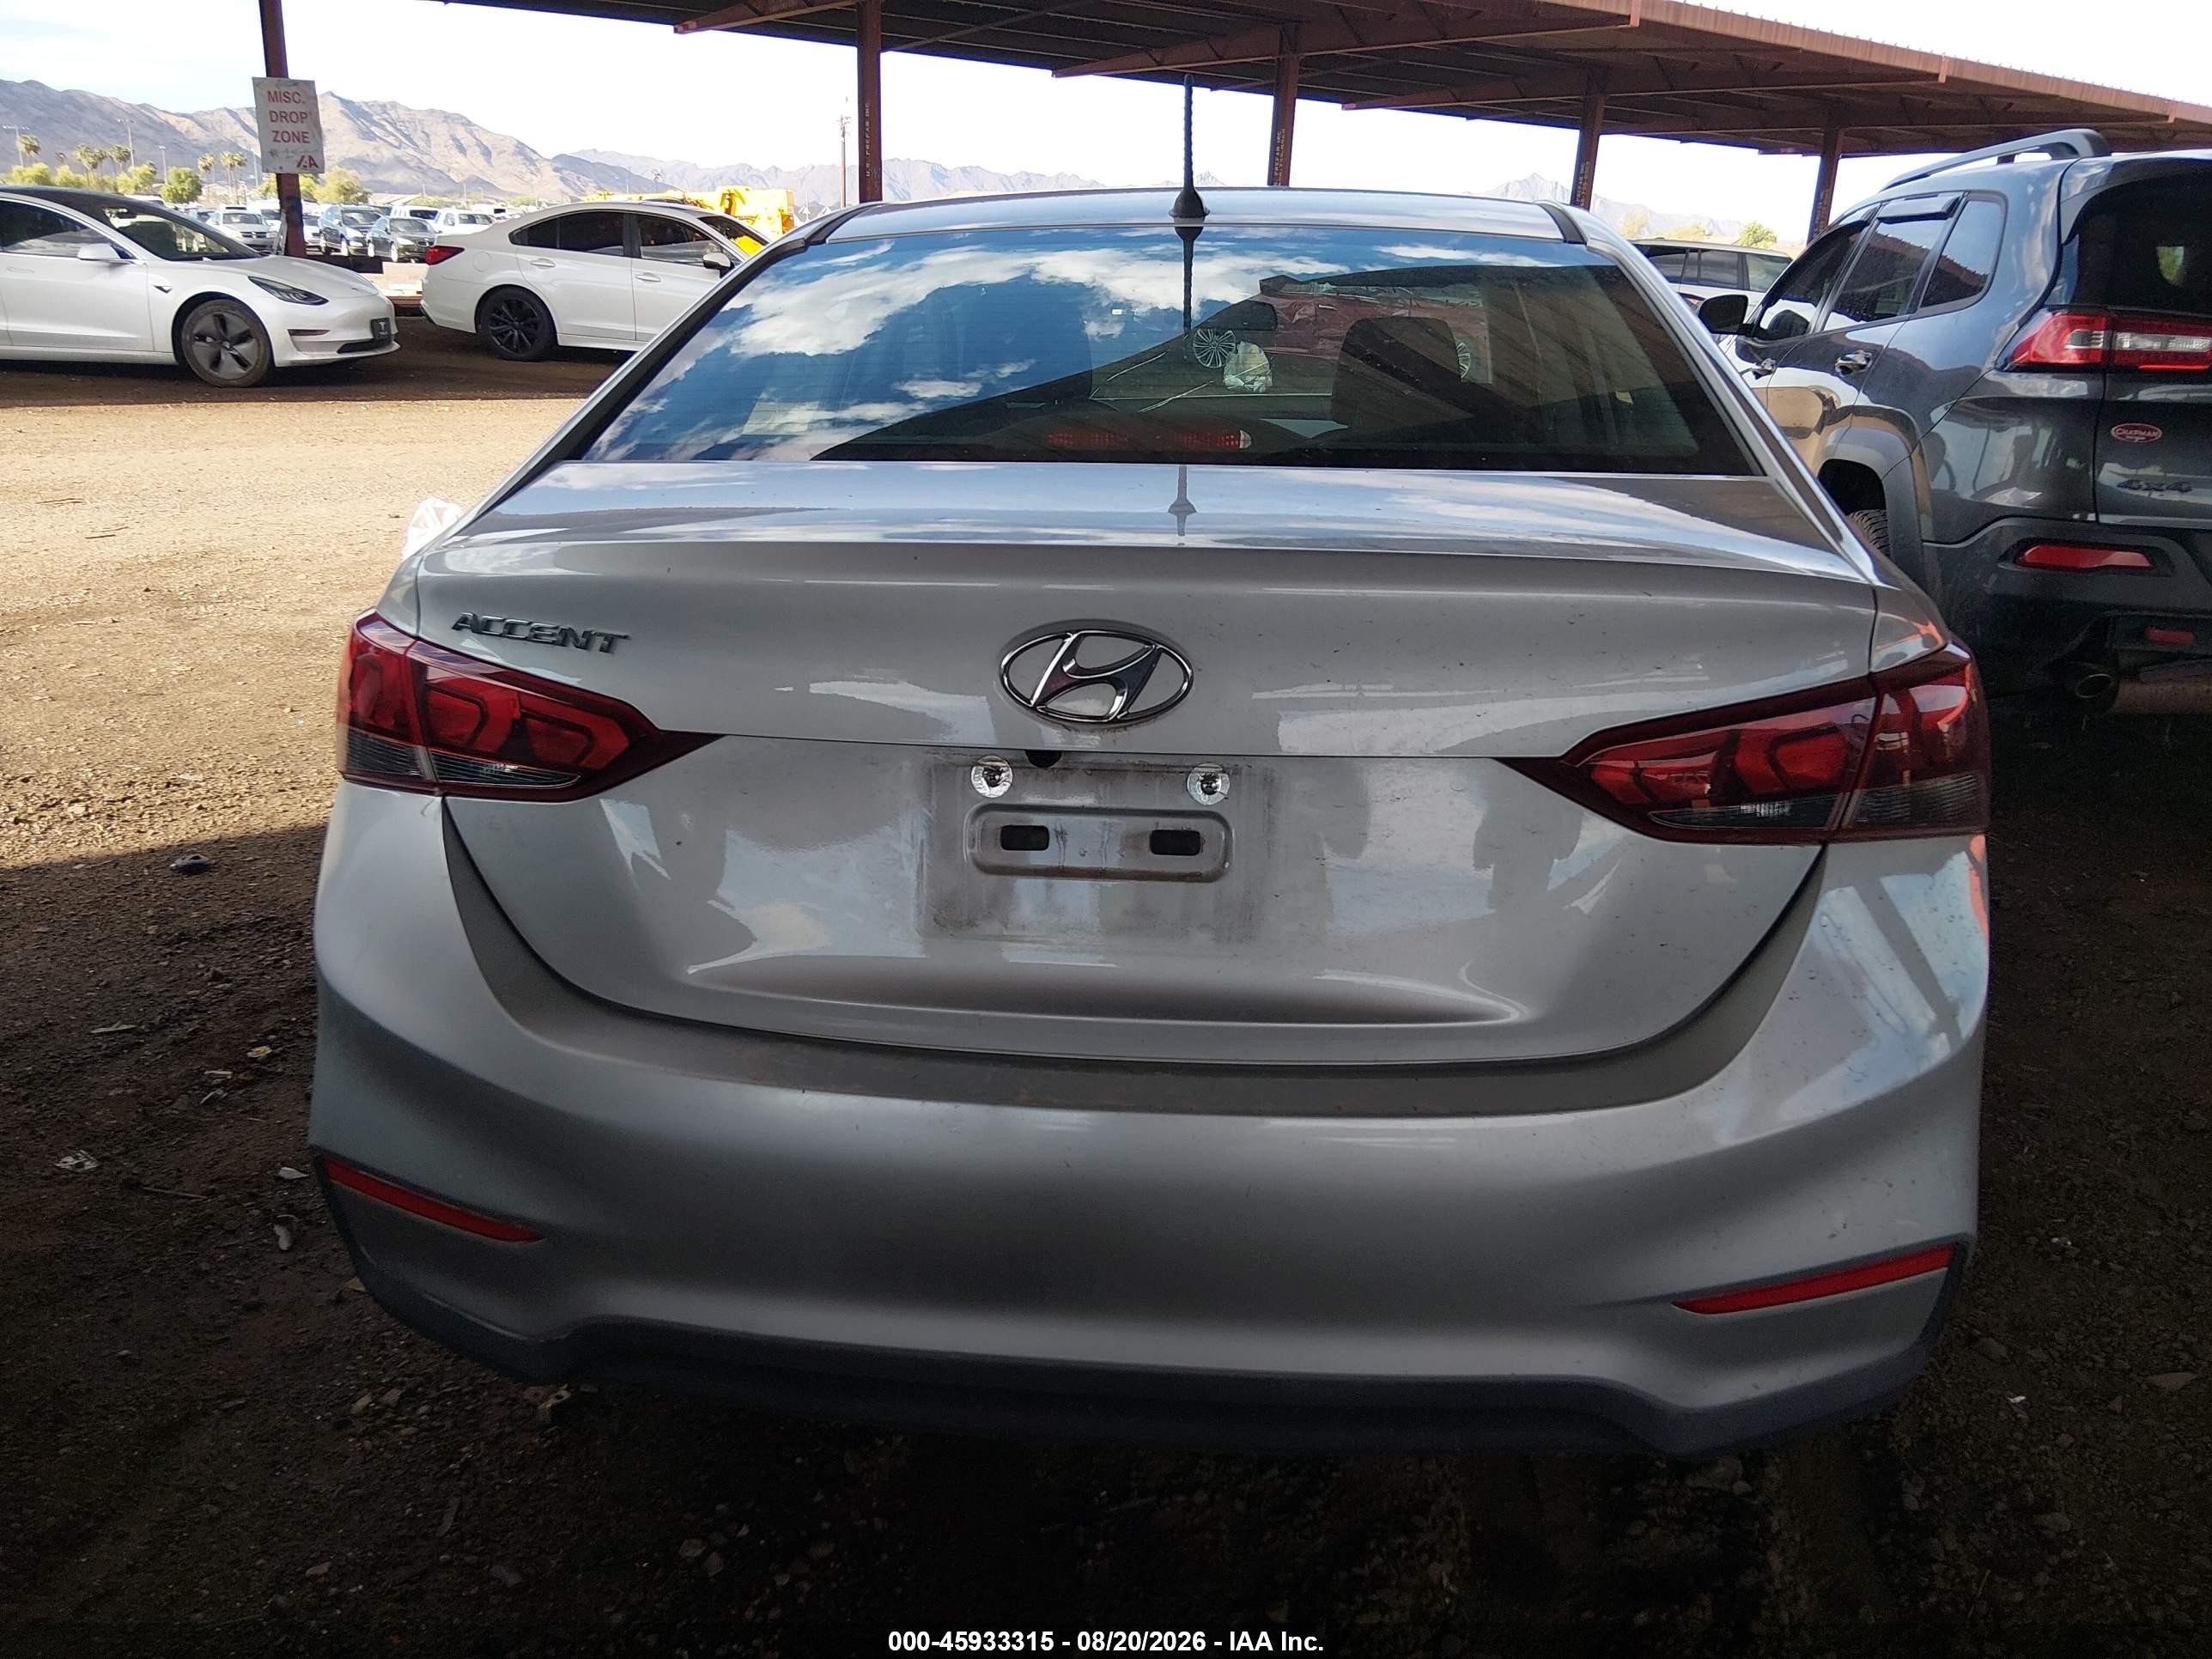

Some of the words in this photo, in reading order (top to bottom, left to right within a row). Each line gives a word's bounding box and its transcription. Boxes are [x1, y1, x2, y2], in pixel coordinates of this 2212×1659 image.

[267, 90, 307, 104] MISC.
[269, 110, 308, 124] DROP
[271, 131, 310, 143] ZONE
[452, 611, 632, 653] ACCENT
